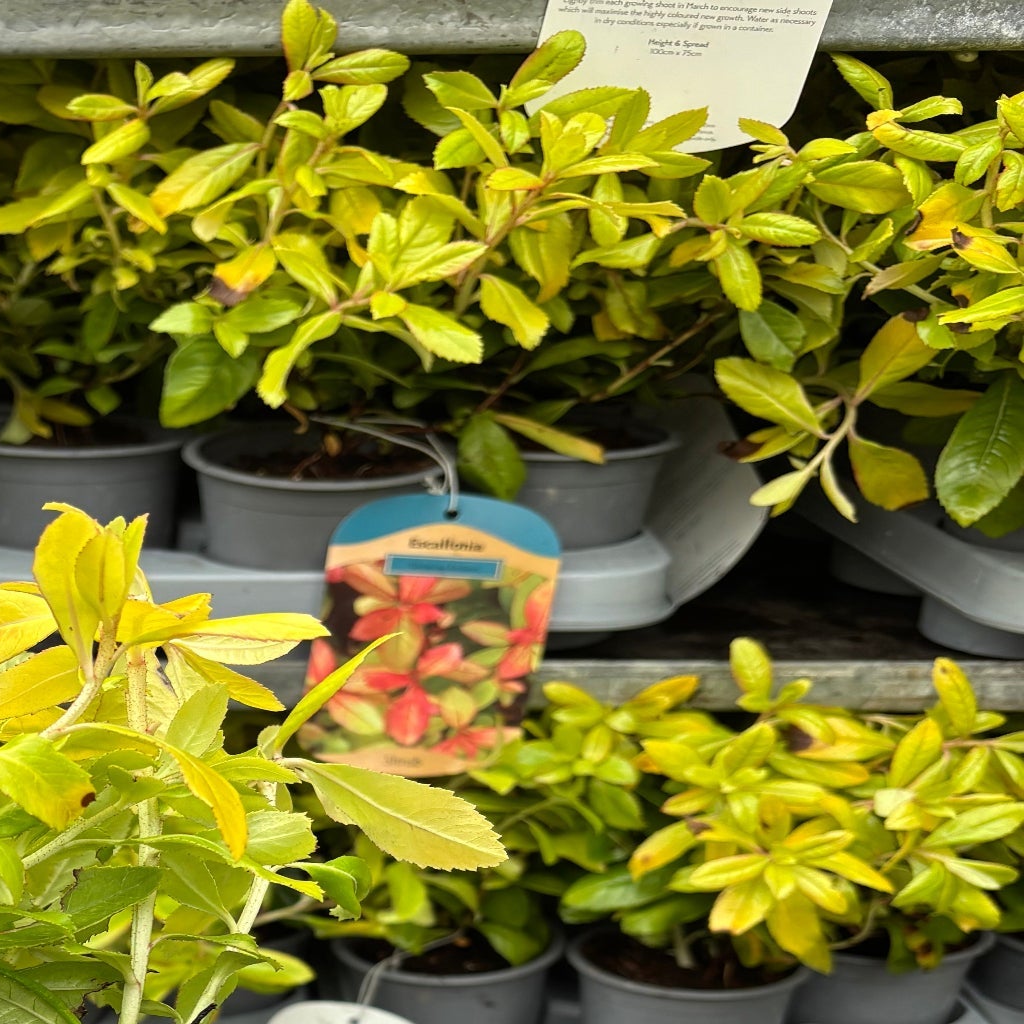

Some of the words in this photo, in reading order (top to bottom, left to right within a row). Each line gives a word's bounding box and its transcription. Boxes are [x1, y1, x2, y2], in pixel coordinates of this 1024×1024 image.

[624, 0, 654, 9] growing
[720, 7, 758, 15] encourage
[775, 7, 792, 15] side
[792, 8, 817, 16] shoots
[602, 17, 616, 26] dry
[616, 19, 655, 27] conditions
[656, 21, 692, 30] especially
[692, 21, 700, 29] if
[738, 25, 774, 33] container.
[643, 10, 665, 19] highly
[667, 11, 700, 19] coloured
[716, 15, 744, 23] growth.
[747, 15, 769, 23] Water
[779, 18, 817, 27] necessary
[648, 38, 673, 48] Height
[682, 39, 711, 49] Spread
[408, 537, 484, 552] Escallonia
